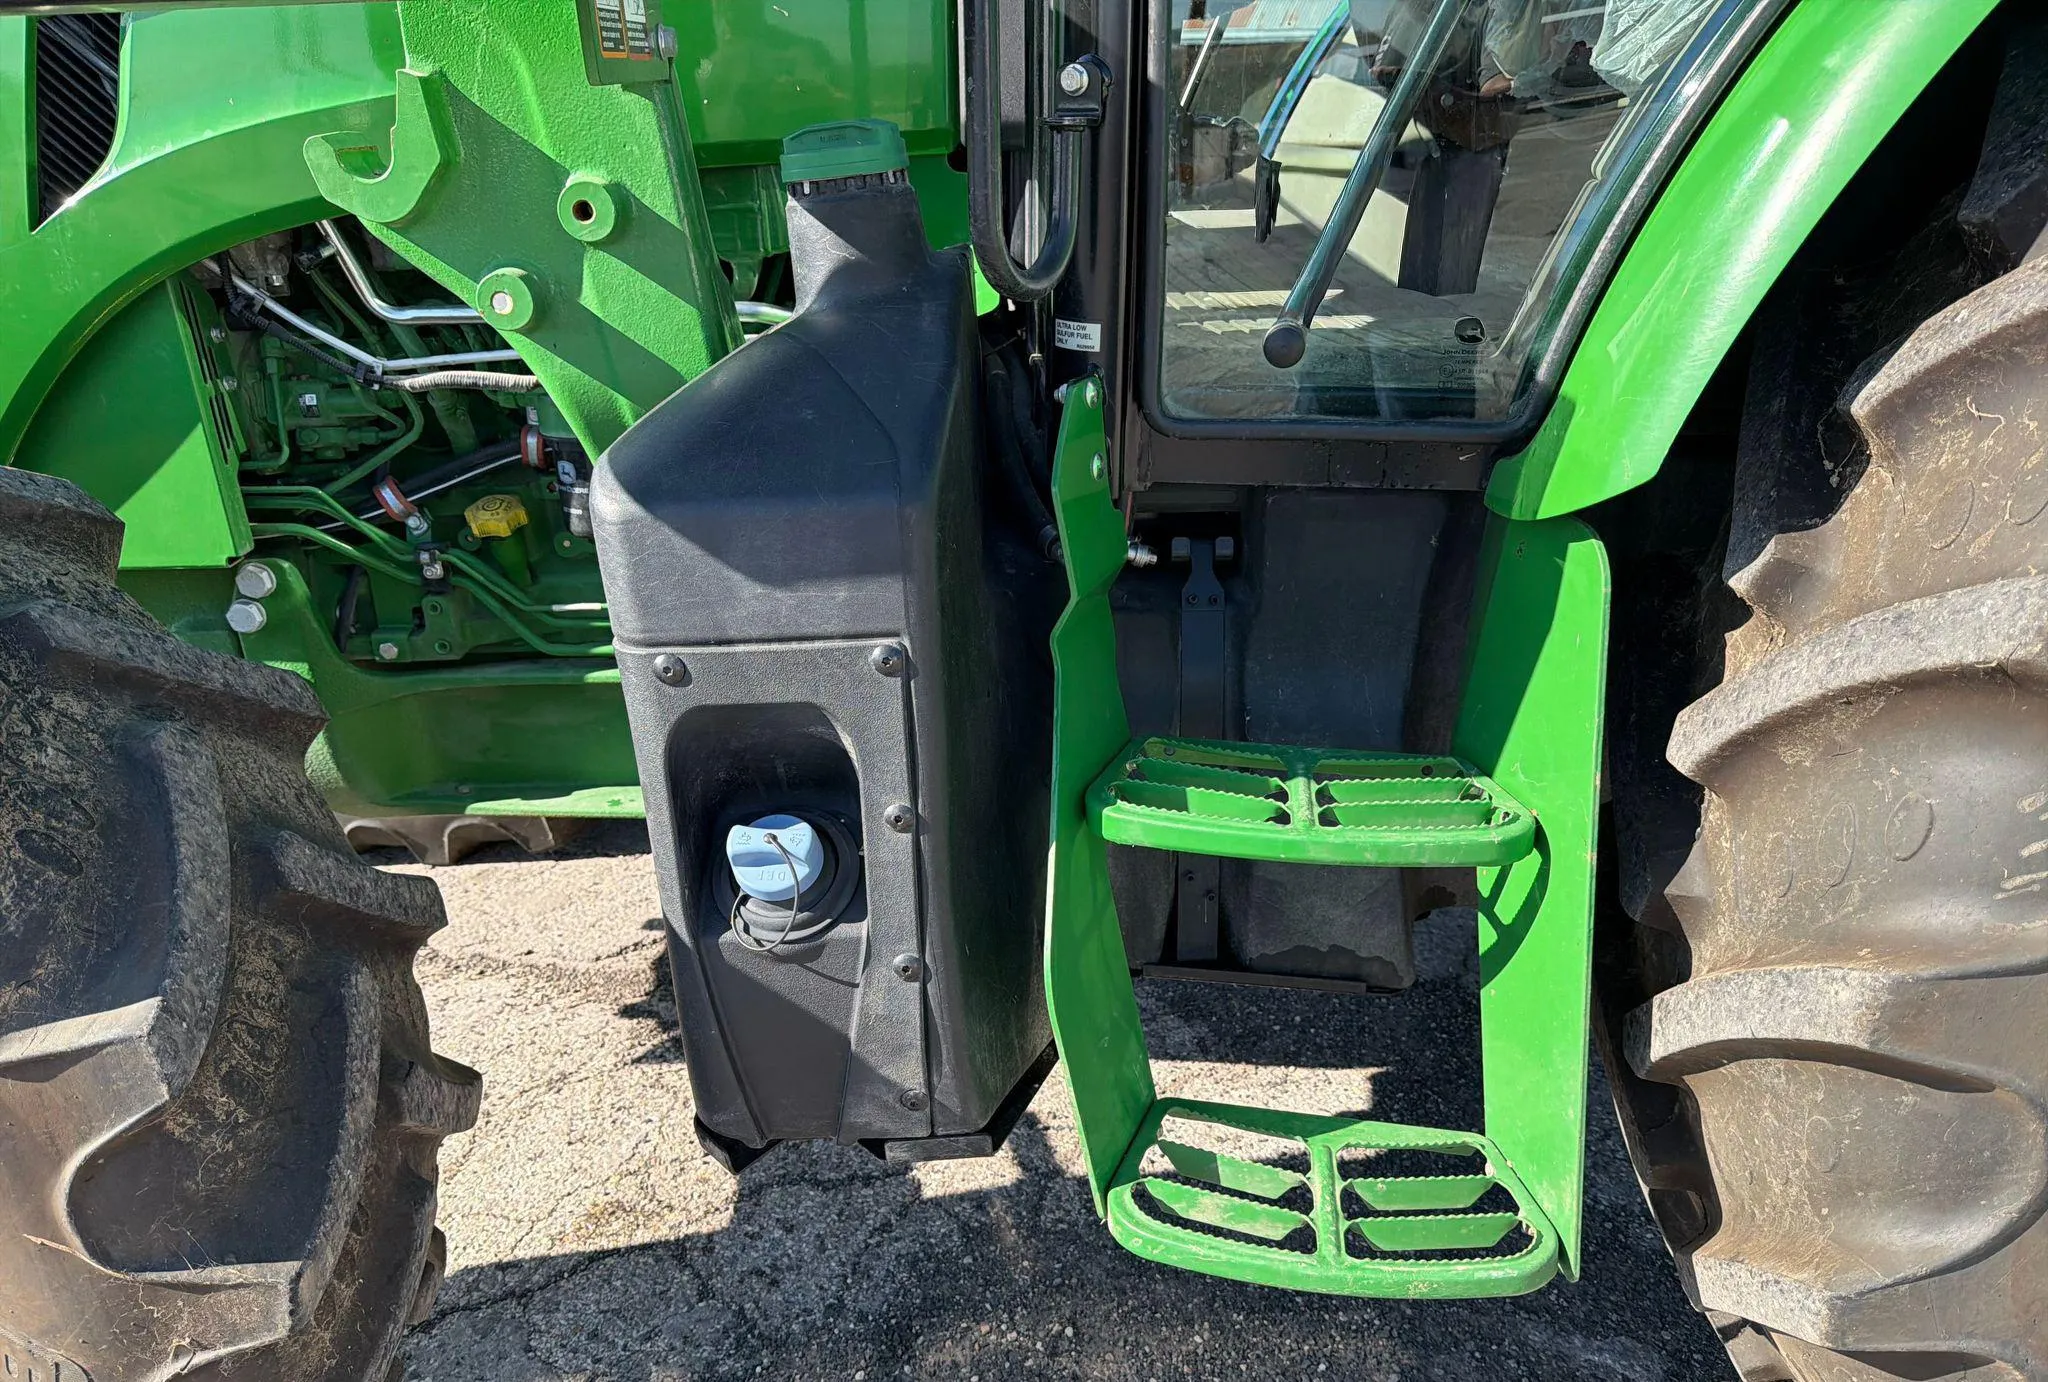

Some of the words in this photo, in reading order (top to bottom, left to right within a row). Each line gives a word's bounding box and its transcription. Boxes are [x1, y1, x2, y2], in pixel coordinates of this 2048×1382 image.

[1057, 321, 1071, 330] ULTRA
[1057, 329, 1075, 338] SULFUR
[1076, 332, 1093, 340] FUEL
[1057, 336, 1069, 345] ONLY
[758, 870, 786, 881] DEF
